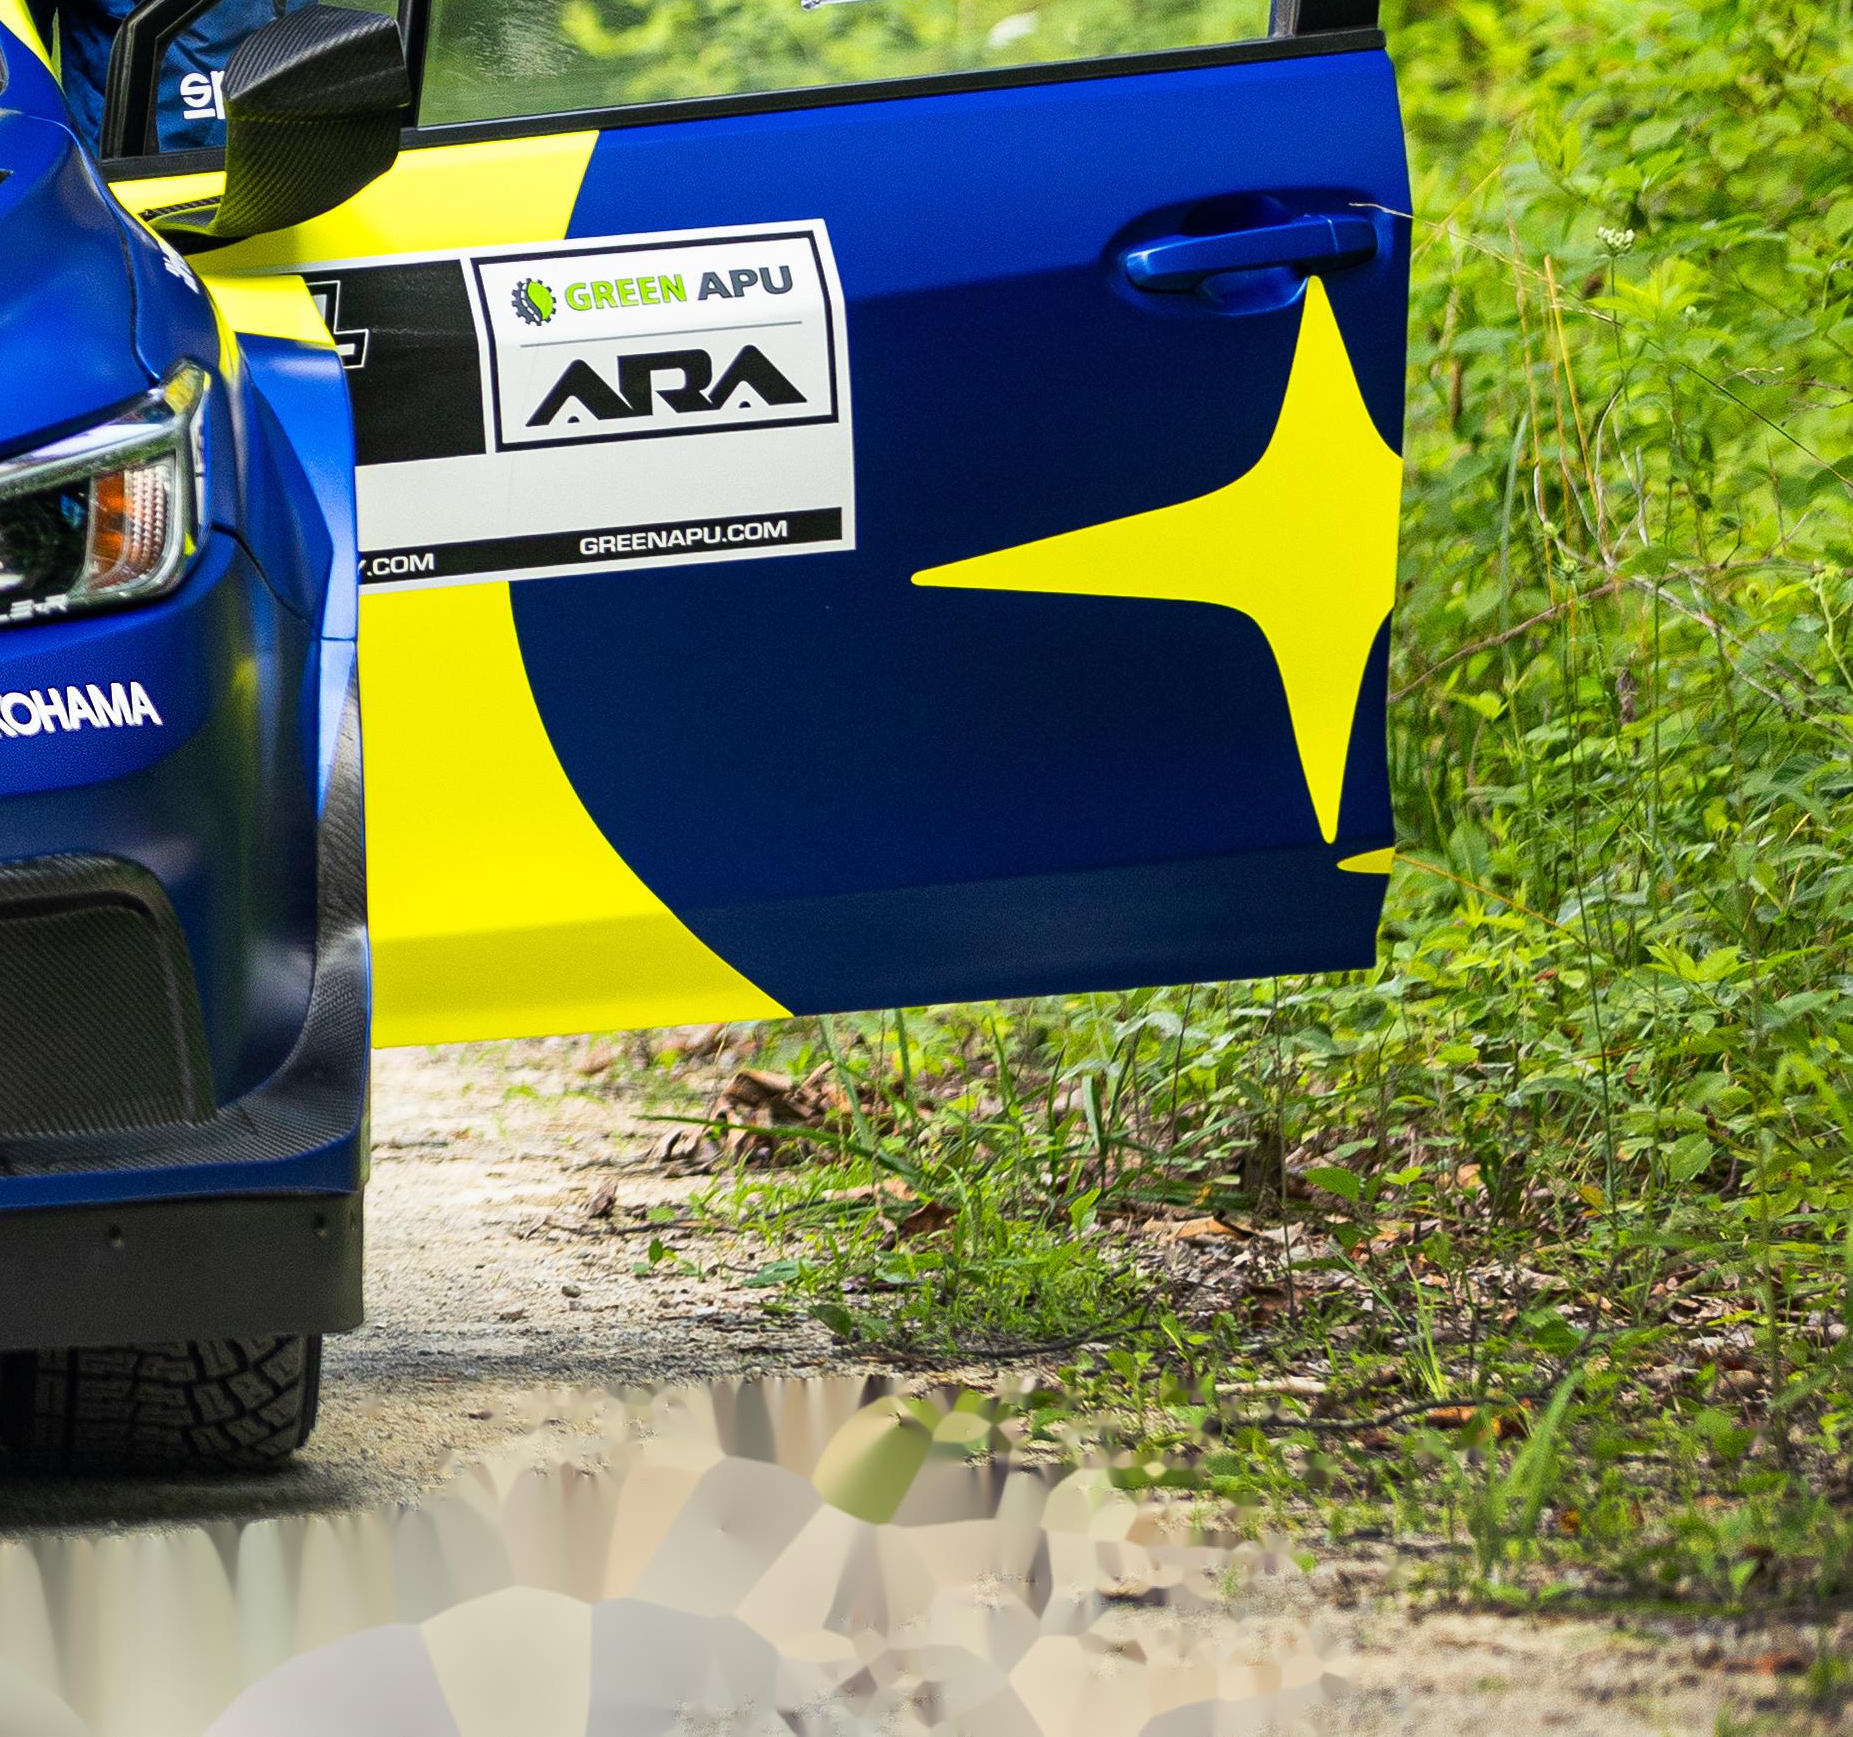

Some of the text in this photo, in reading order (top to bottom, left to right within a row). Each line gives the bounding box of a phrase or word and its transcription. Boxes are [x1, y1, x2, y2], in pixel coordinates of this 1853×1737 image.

[564, 265, 793, 312] GREEN APU
[524, 343, 809, 428] ARA
[579, 518, 789, 556] GREENAPU.COM
